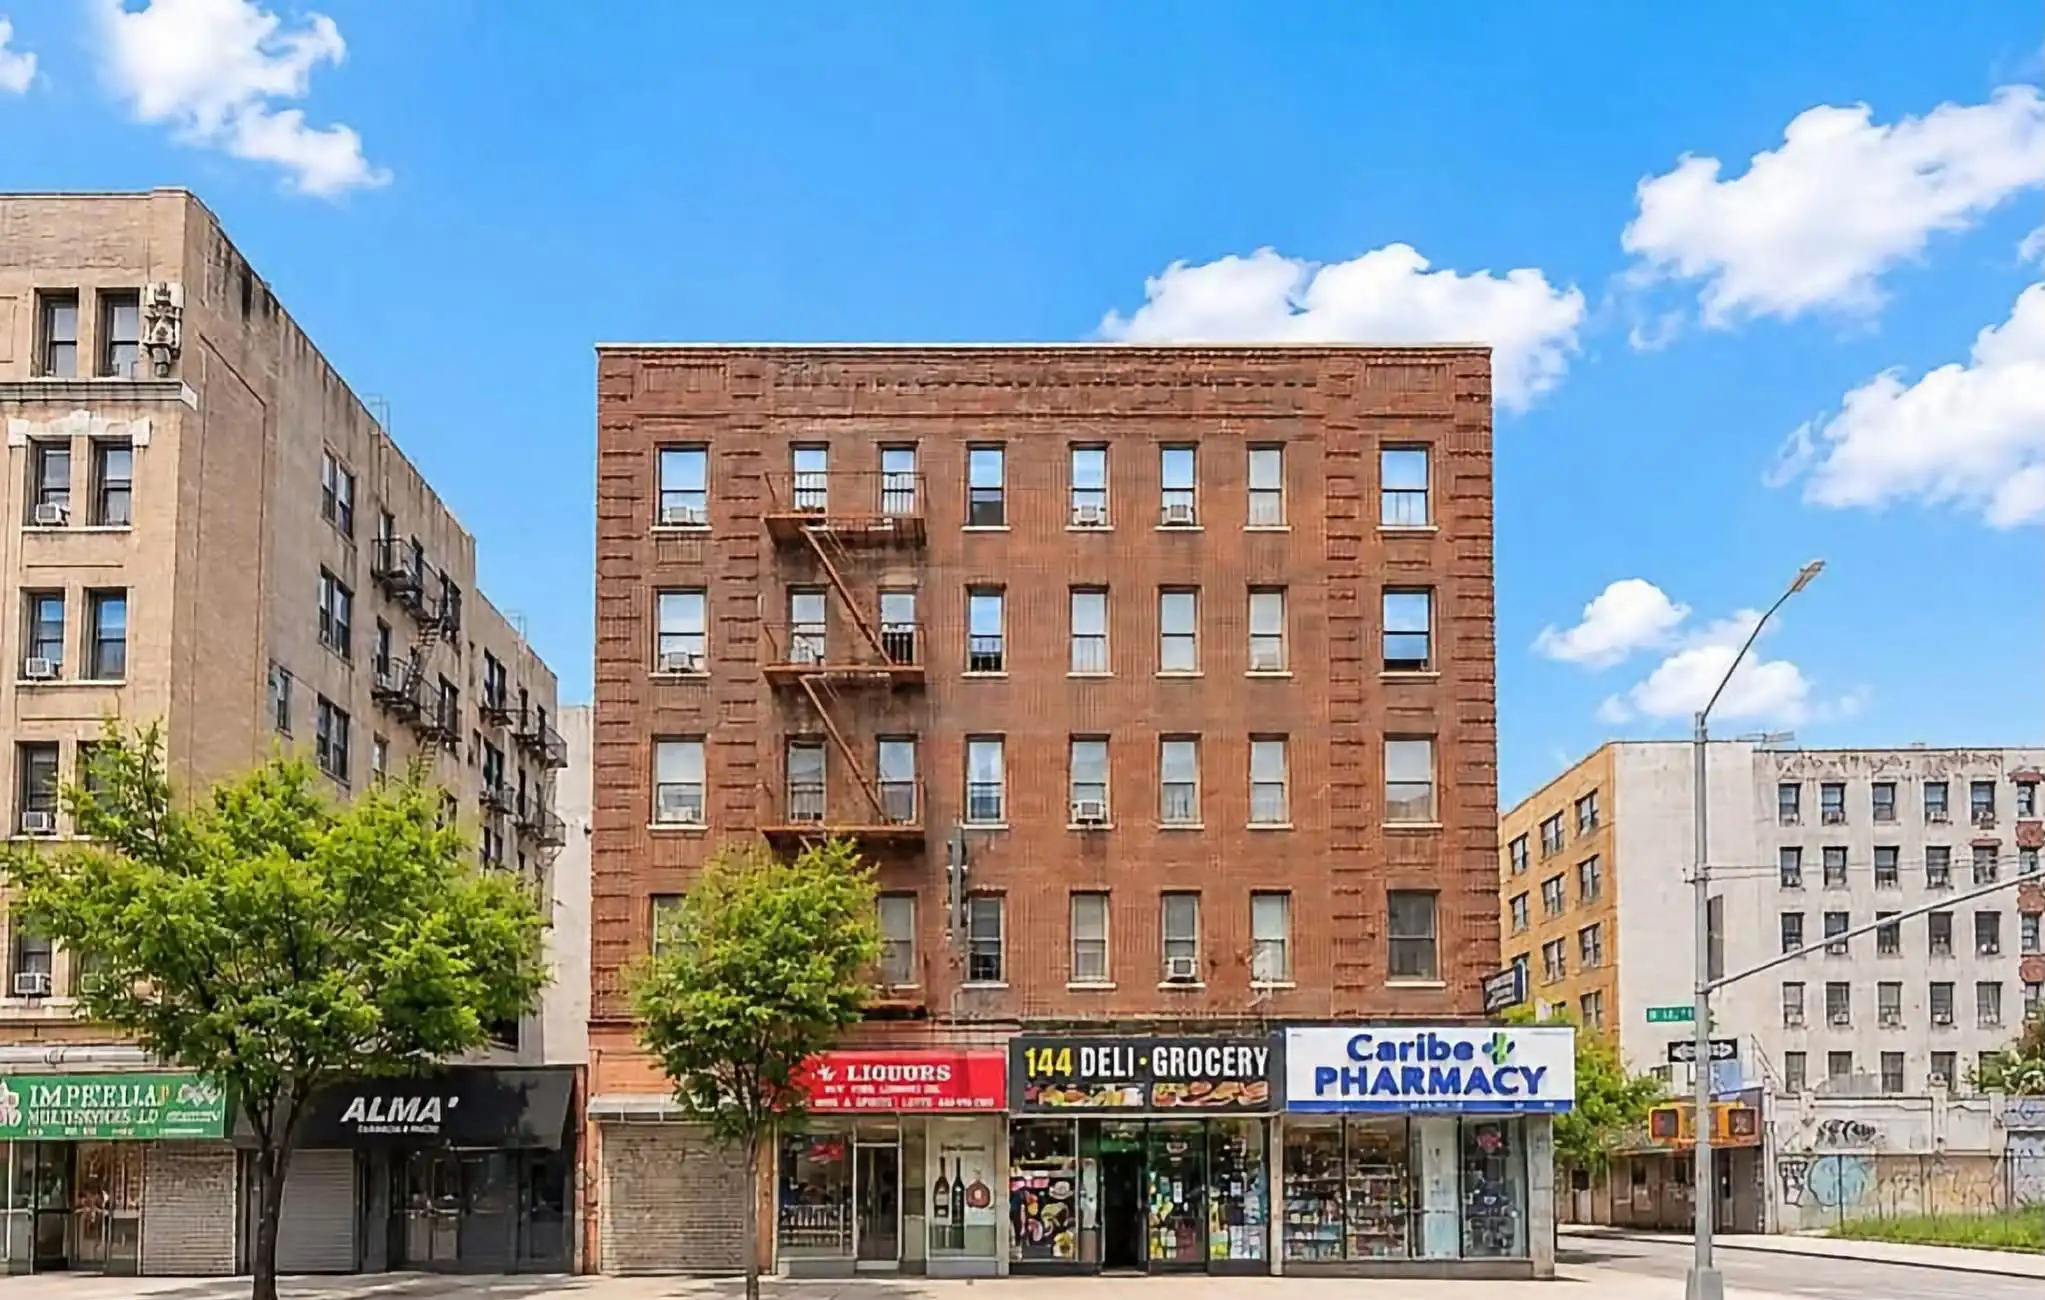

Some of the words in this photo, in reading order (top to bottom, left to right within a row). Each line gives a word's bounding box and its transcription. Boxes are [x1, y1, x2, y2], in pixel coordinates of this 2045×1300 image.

[847, 1064, 951, 1082] LIQUORS
[1024, 1047, 1073, 1077] 144
[1080, 1047, 1134, 1077] DELI
[1152, 1046, 1269, 1077] GROCERY
[1315, 1066, 1547, 1096] PHARMACY
